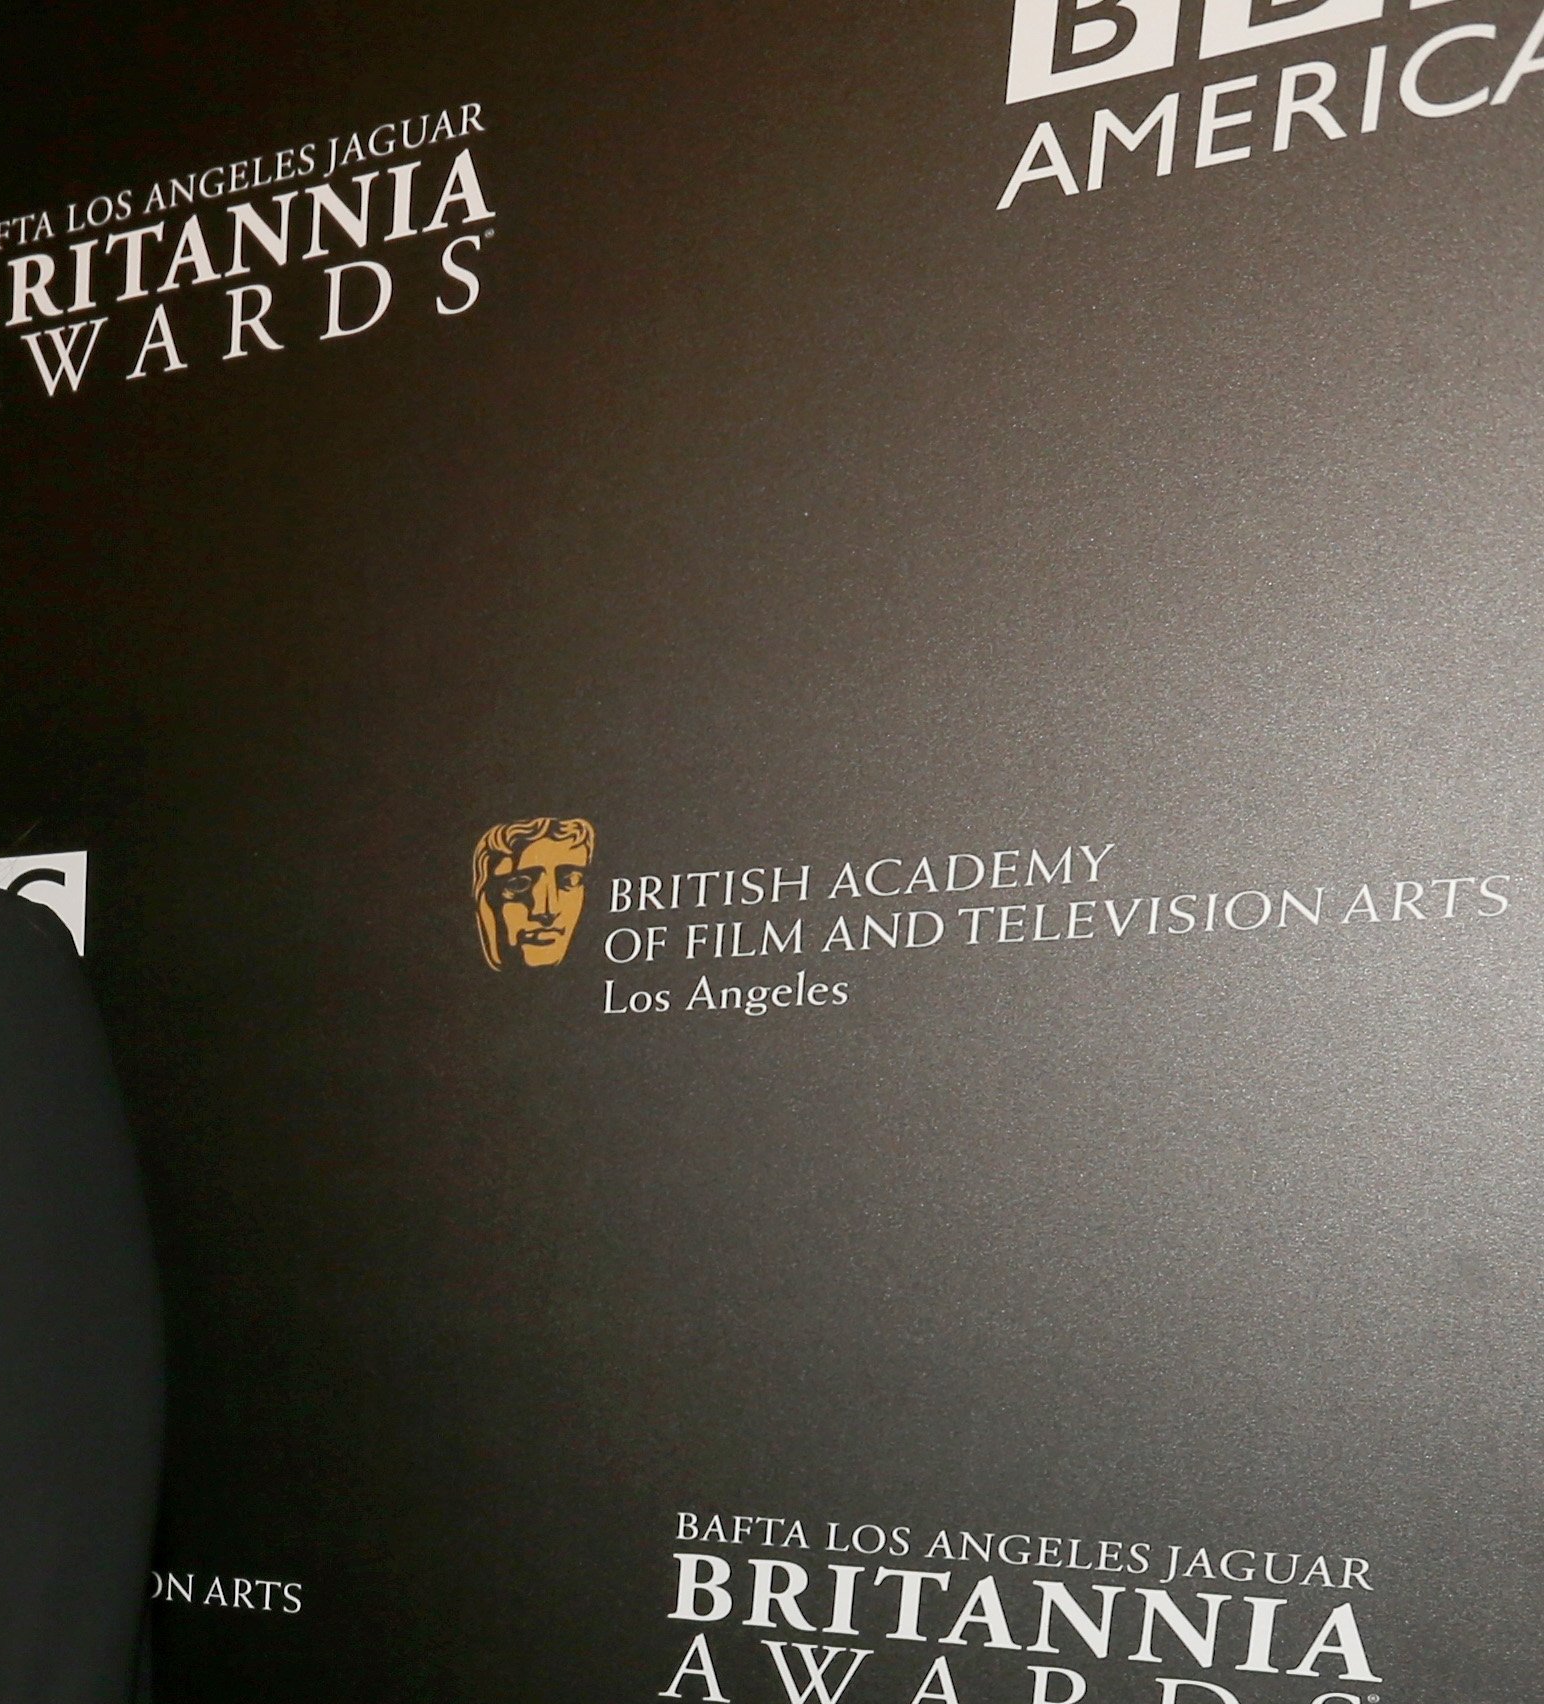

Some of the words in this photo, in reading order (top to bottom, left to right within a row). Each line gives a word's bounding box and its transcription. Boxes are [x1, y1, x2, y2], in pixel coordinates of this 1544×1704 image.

[67, 189, 132, 233] LOS
[143, 143, 316, 214] ANGELES
[323, 102, 485, 178] JAGUAR
[609, 865, 810, 913] BRITISH
[828, 843, 1116, 899] ACADEMY
[604, 926, 668, 964] OF
[686, 918, 802, 960] FILM
[821, 910, 944, 953] AND
[958, 886, 1327, 945] TELEVISION
[1340, 874, 1512, 924] ARTS
[603, 979, 670, 1014] Los
[685, 969, 849, 1017] Angeles
[676, 1512, 810, 1549] BAFTA
[825, 1522, 911, 1556] LOS
[924, 1529, 1151, 1574] ANGELES
[1159, 1545, 1374, 1591] JAGUAR
[203, 1575, 303, 1614] ARTS
[667, 1552, 1383, 1683] BRITANNIA
